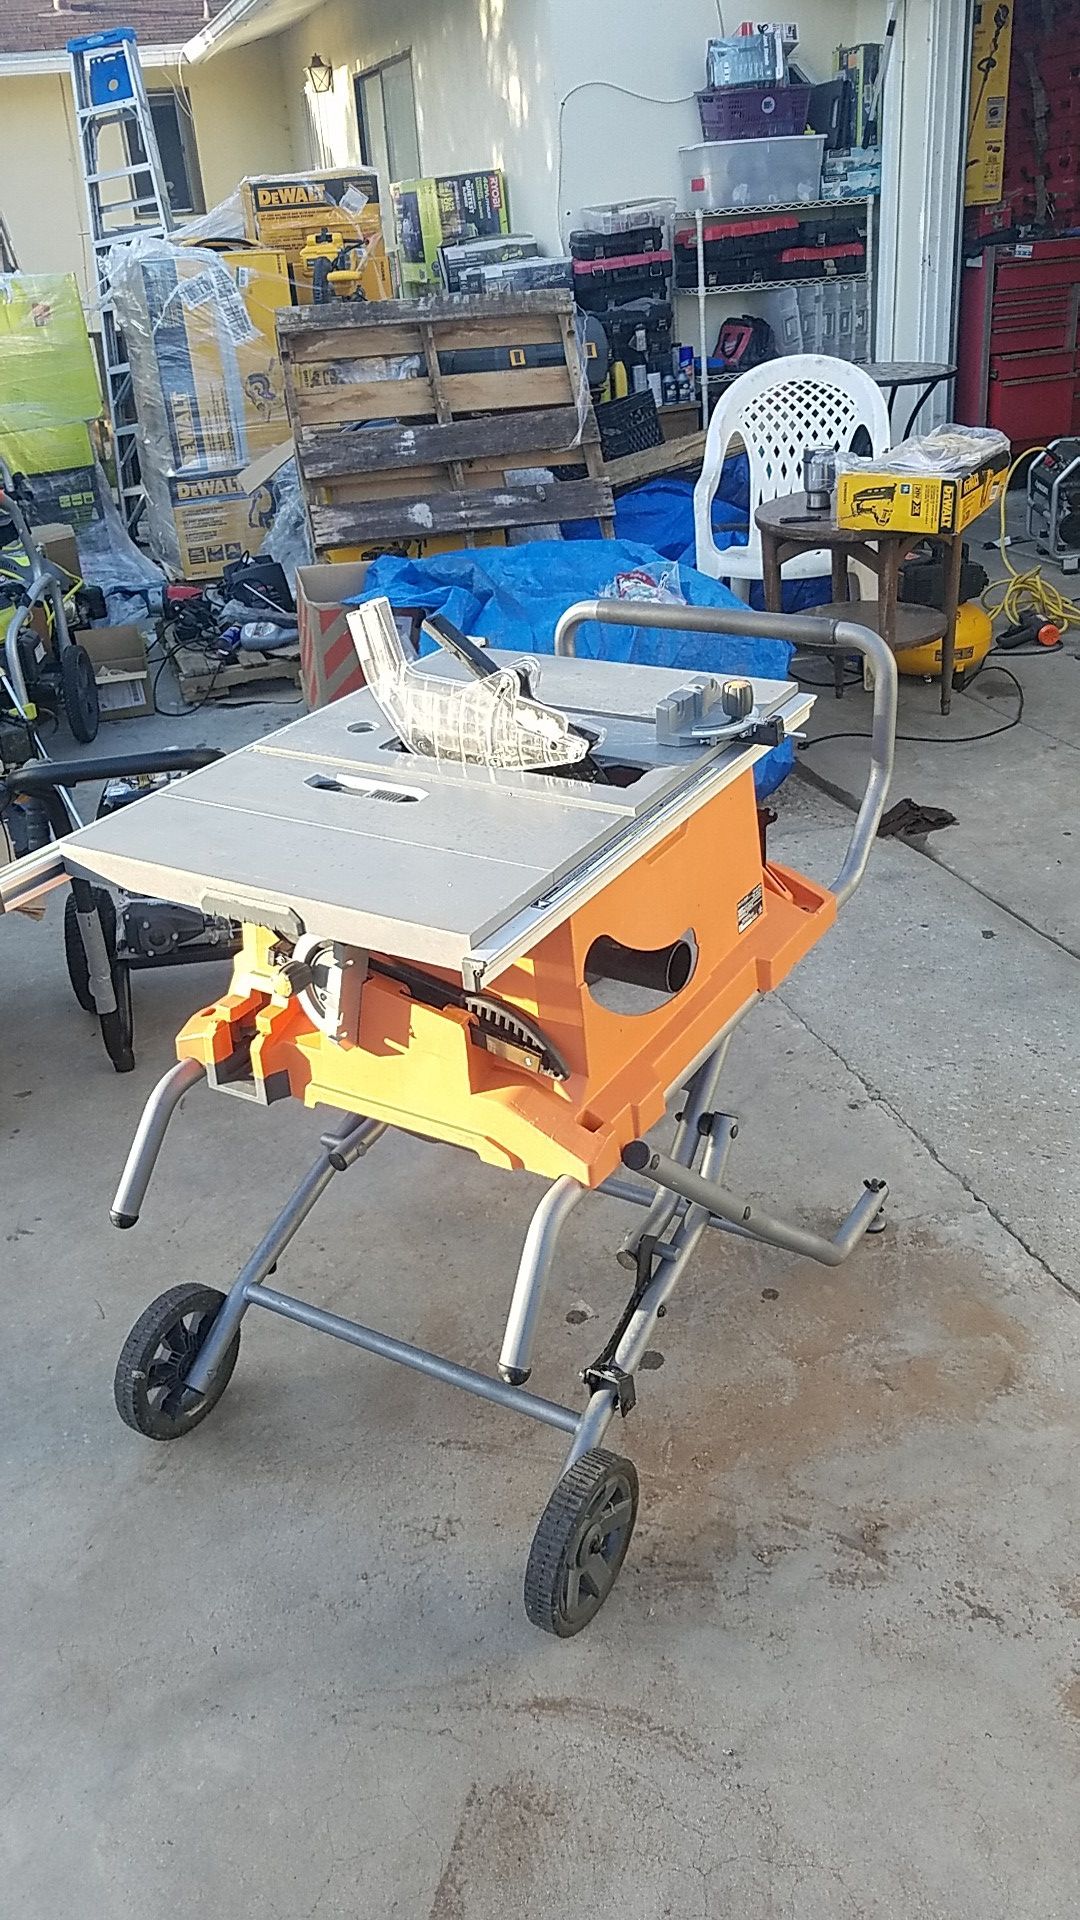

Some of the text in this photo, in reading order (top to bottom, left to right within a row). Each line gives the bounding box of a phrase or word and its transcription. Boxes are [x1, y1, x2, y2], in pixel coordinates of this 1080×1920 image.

[258, 185, 325, 206] DEWALT
[465, 179, 475, 214] QUIETEST
[490, 176, 500, 208] RYOBI
[941, 485, 954, 529] DEWALT
